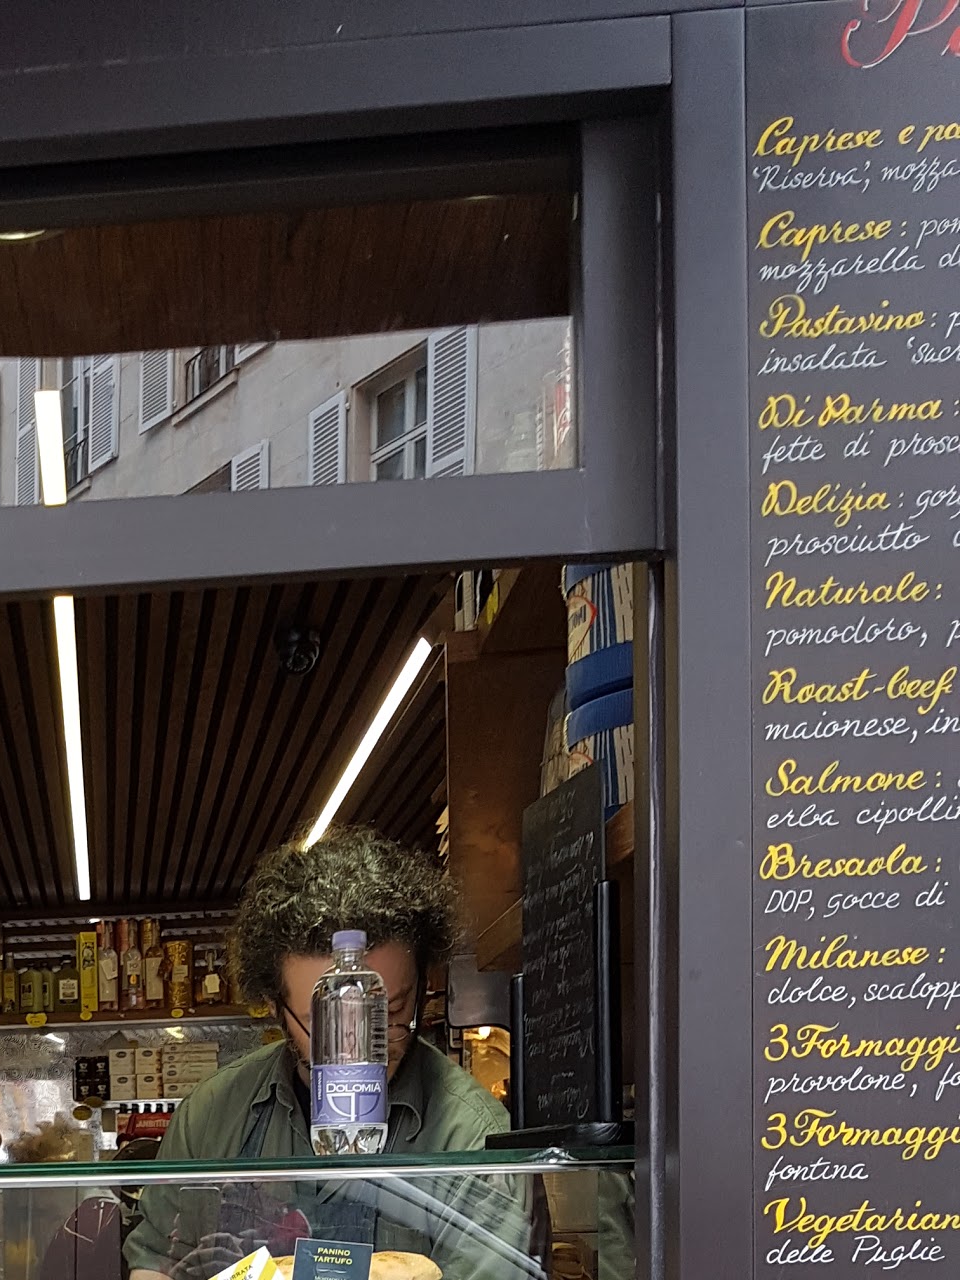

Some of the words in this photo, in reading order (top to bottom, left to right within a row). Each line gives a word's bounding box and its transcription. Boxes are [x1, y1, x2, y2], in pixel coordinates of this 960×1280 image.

[752, 116, 884, 167] Caprese
[898, 125, 916, 144] e
[759, 246, 925, 294] mozzarella
[758, 343, 887, 376] insalata
[762, 434, 826, 475] fette
[843, 430, 874, 459] di
[764, 523, 930, 567] prosciutto
[764, 615, 928, 657] pomodoro,
[761, 665, 958, 715] Roast-beef
[764, 711, 918, 743] maionese,
[767, 803, 840, 829] erba
[764, 889, 816, 921] DOP,
[823, 891, 900, 918] gocce
[915, 881, 949, 907] di
[767, 976, 857, 1009] dolce,
[764, 1065, 918, 1104] provolone,
[764, 1155, 869, 1192] fontina
[313, 1255, 353, 1265] TARTUFO
[317, 1247, 351, 1257] PANINO
[766, 1238, 835, 1265] delle
[851, 1235, 946, 1270] Puglie
